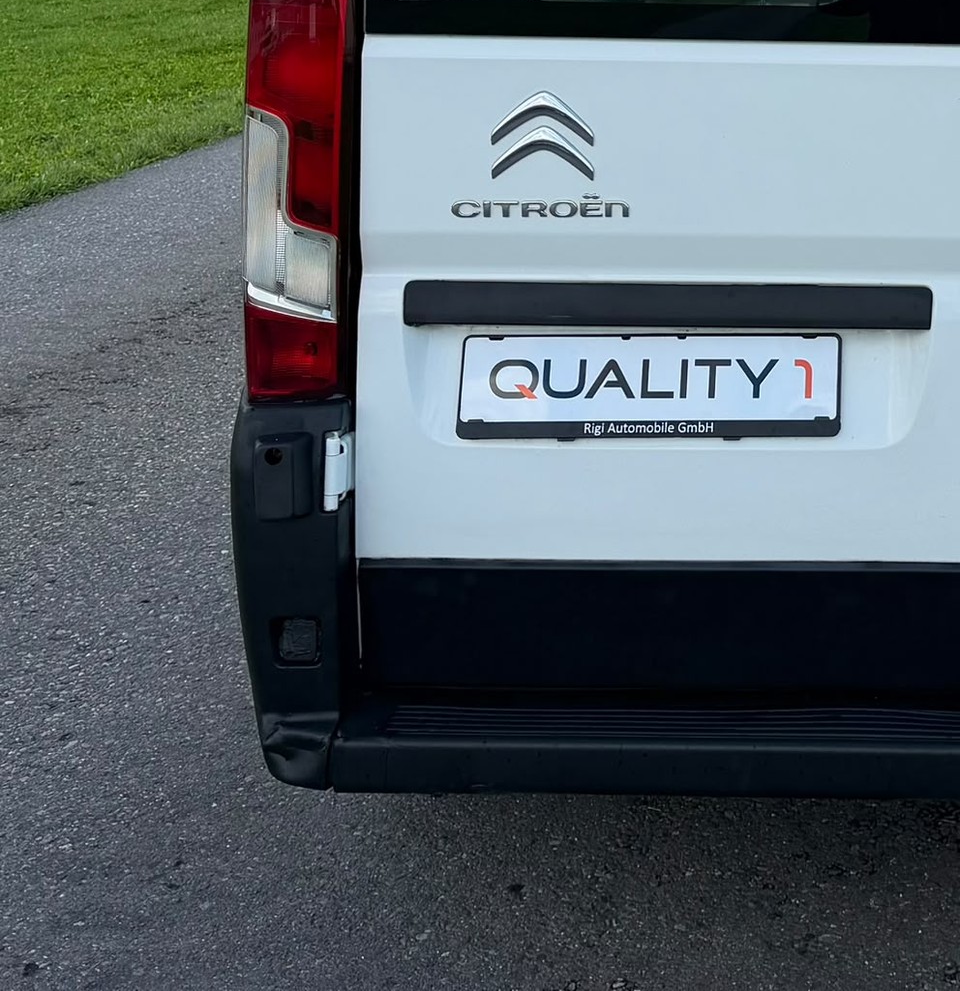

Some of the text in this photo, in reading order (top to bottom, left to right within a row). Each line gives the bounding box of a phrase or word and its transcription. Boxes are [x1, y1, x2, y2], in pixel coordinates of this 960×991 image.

[488, 358, 814, 400] QUALITY 1
[583, 421, 714, 436] Rigi Automobile GmbH
